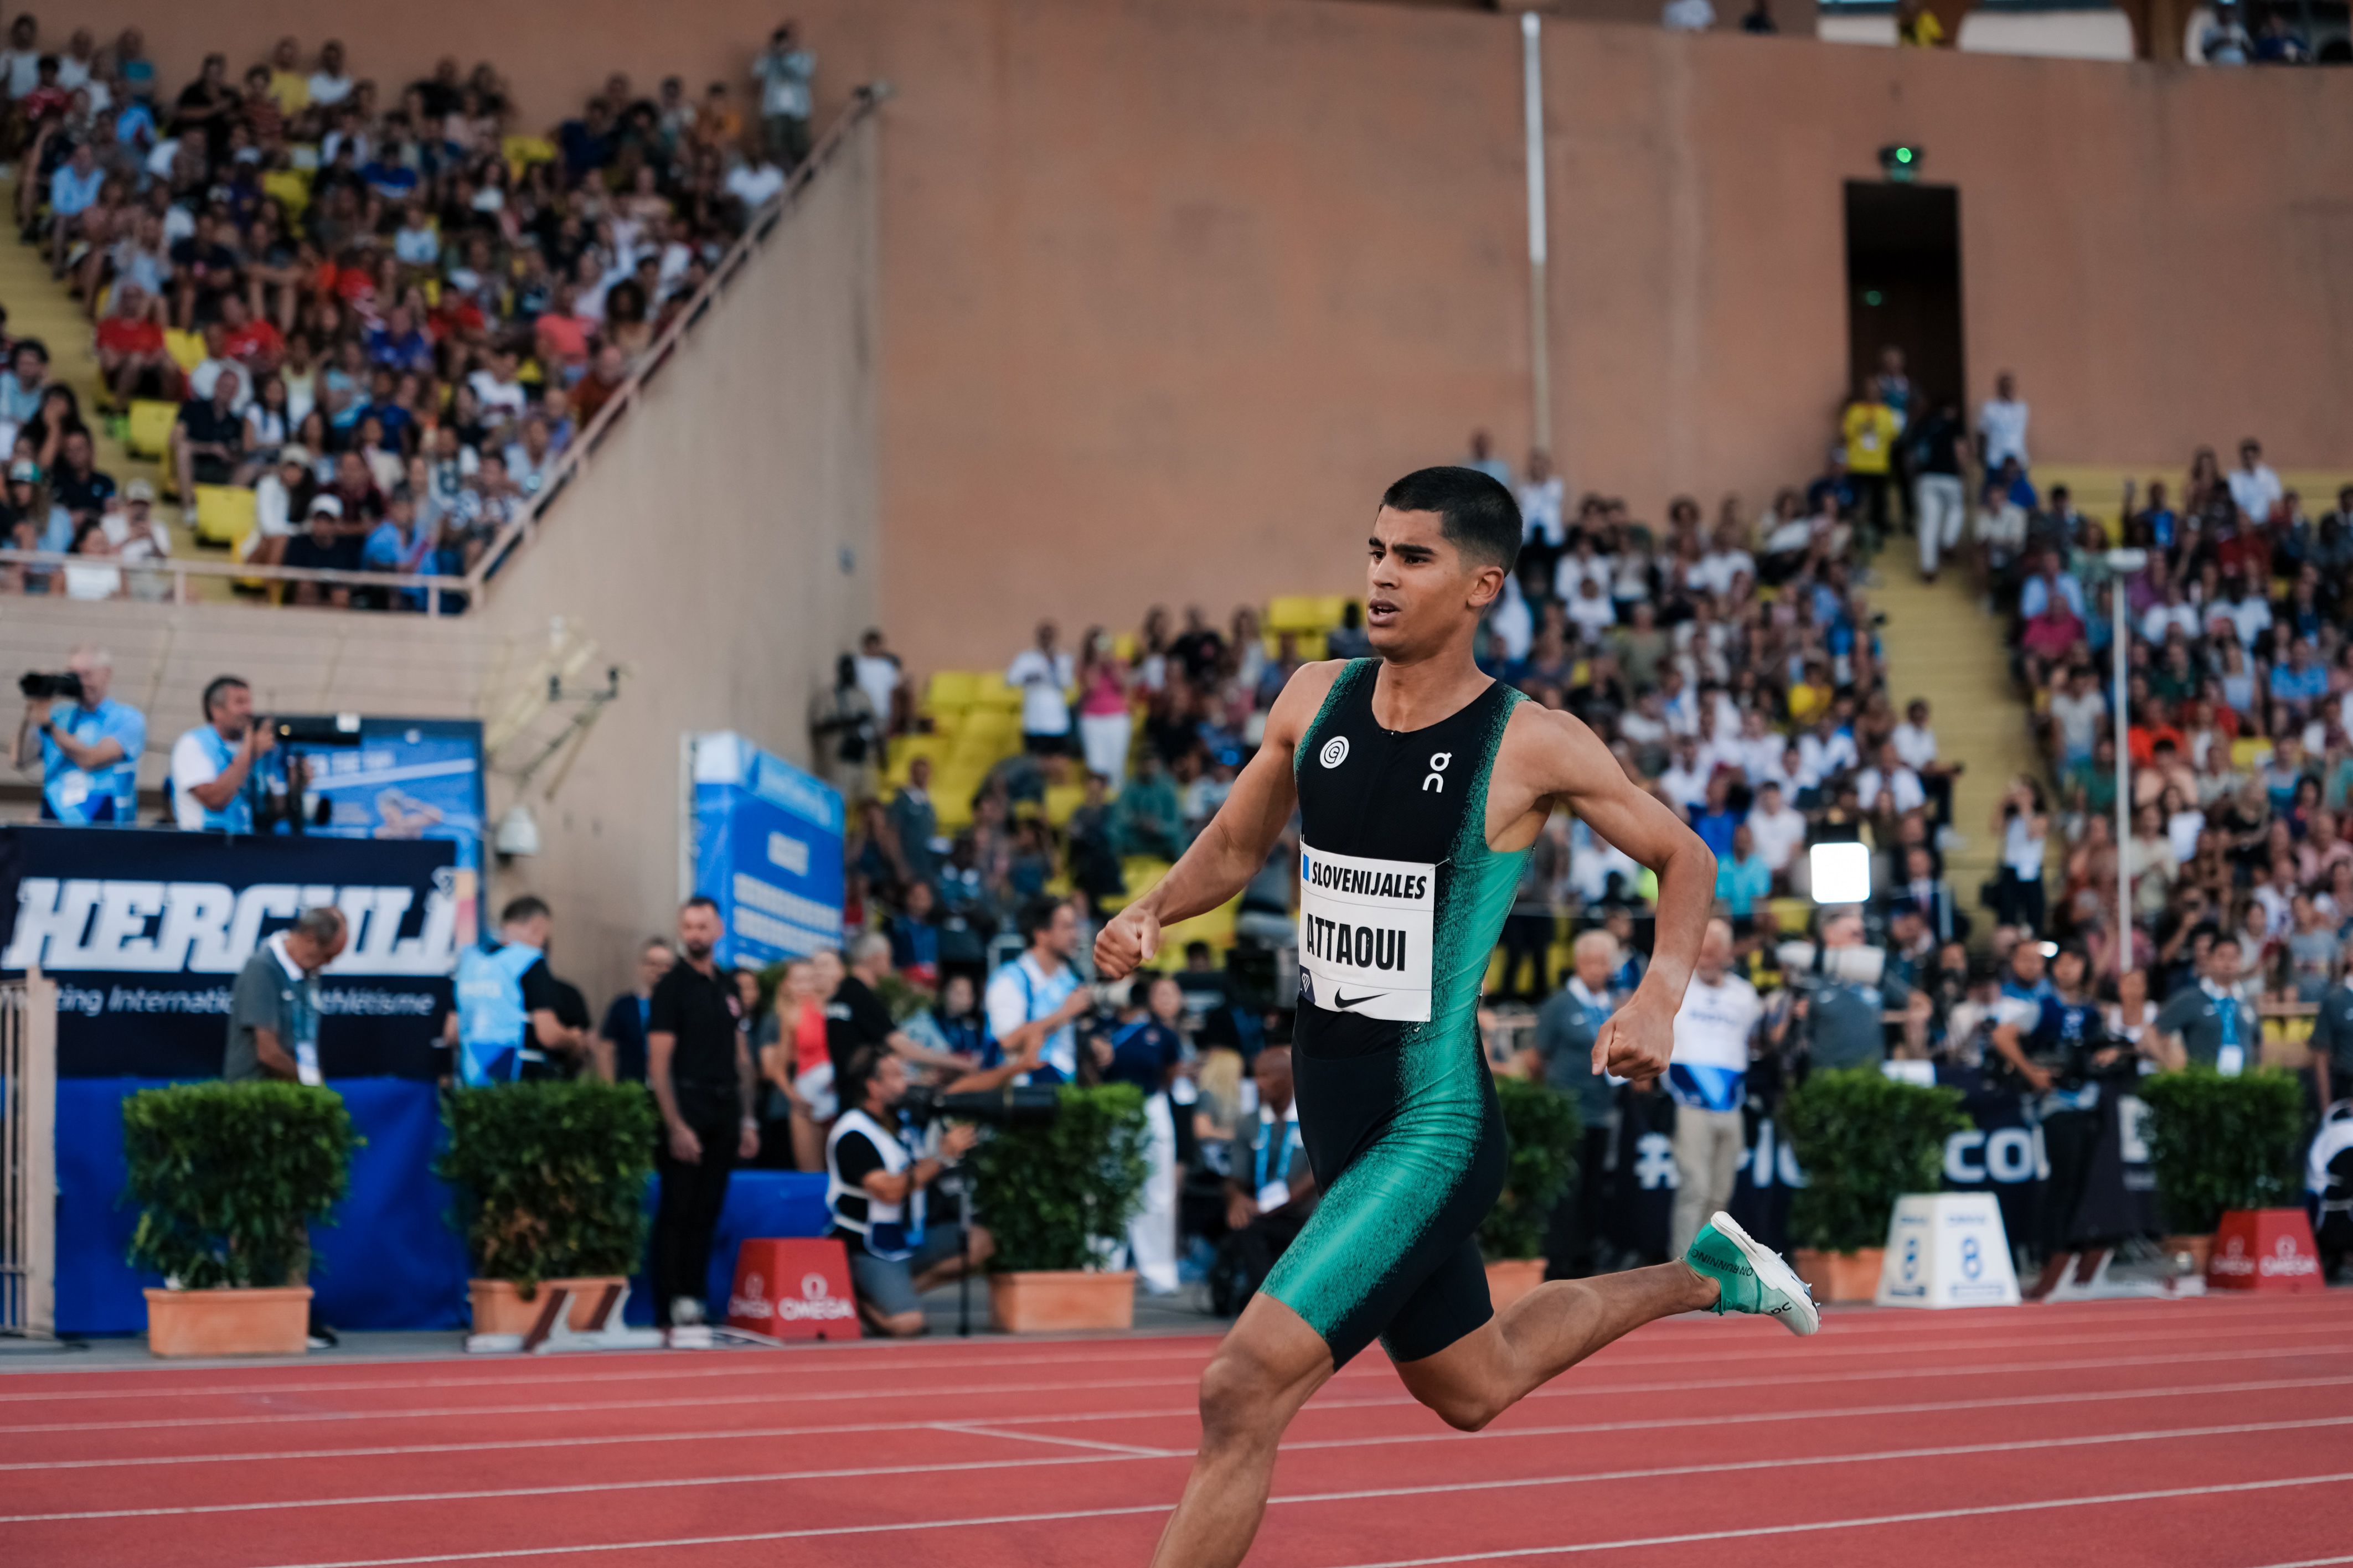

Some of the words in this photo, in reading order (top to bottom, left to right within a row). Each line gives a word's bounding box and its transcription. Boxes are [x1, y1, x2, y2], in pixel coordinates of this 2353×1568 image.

[1312, 861, 1427, 901] SLOVENIJALES
[1307, 913, 1406, 972] ATTAOUI
[777, 1297, 856, 1321] OMEGA
